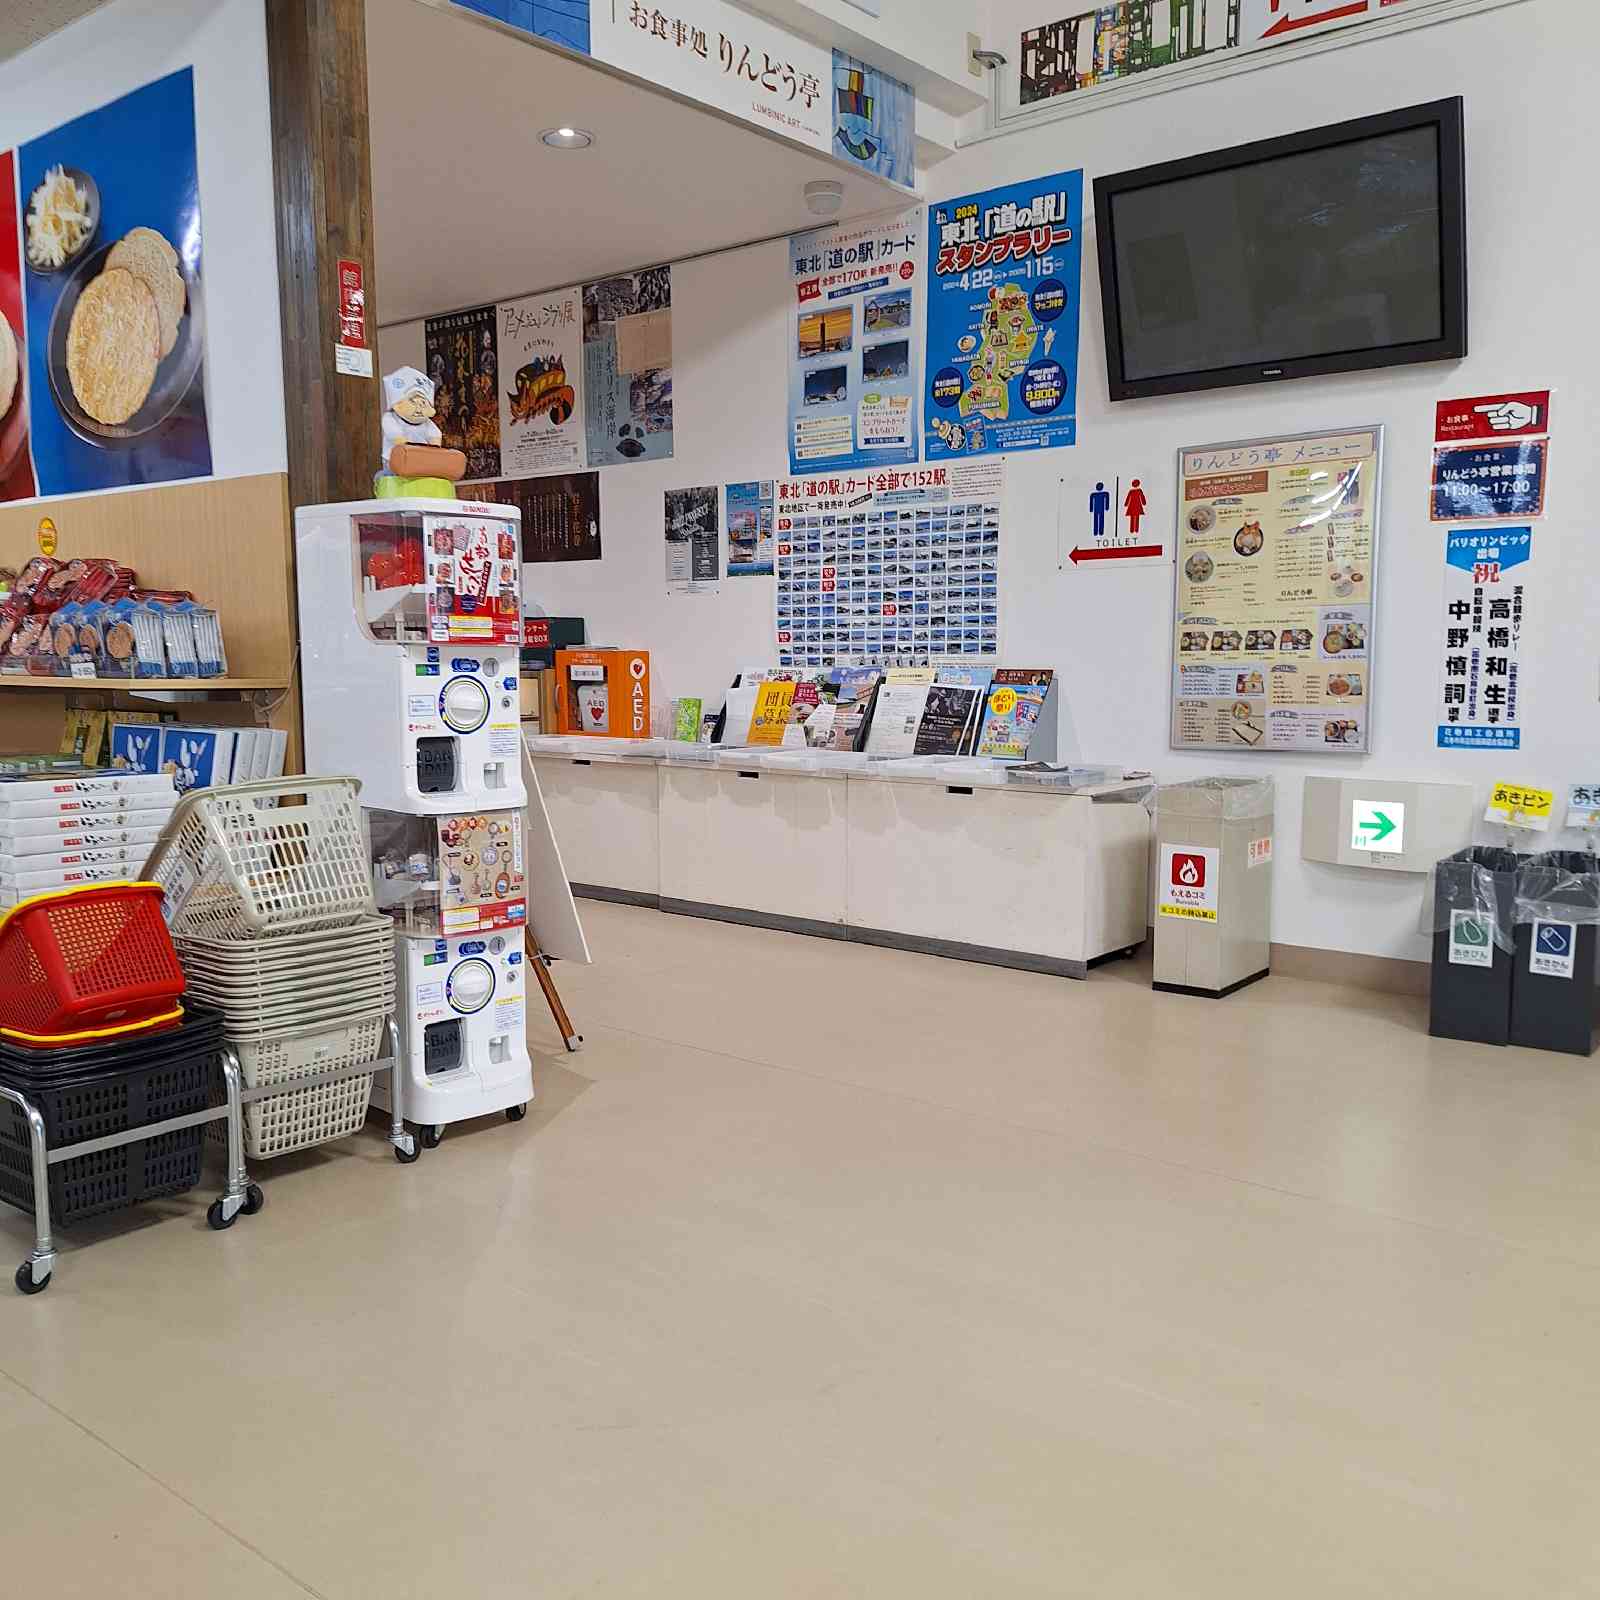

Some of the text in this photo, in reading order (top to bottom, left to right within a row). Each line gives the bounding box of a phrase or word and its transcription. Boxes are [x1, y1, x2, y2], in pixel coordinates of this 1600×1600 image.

[630, 0, 820, 108] お食事処 りんどう亭
[941, 191, 1067, 247] 東北「道の駅」
[795, 234, 916, 276] 東北「道の駅」カード
[936, 225, 1072, 275] スタンプラリー
[1192, 443, 1361, 471] りんどう亭 メニュー
[1095, 537, 1139, 548] TOILET
[1474, 563, 1500, 584] 祝
[587, 699, 605, 708] AED
[632, 681, 645, 731] AED
[1494, 789, 1550, 809] あきビン
